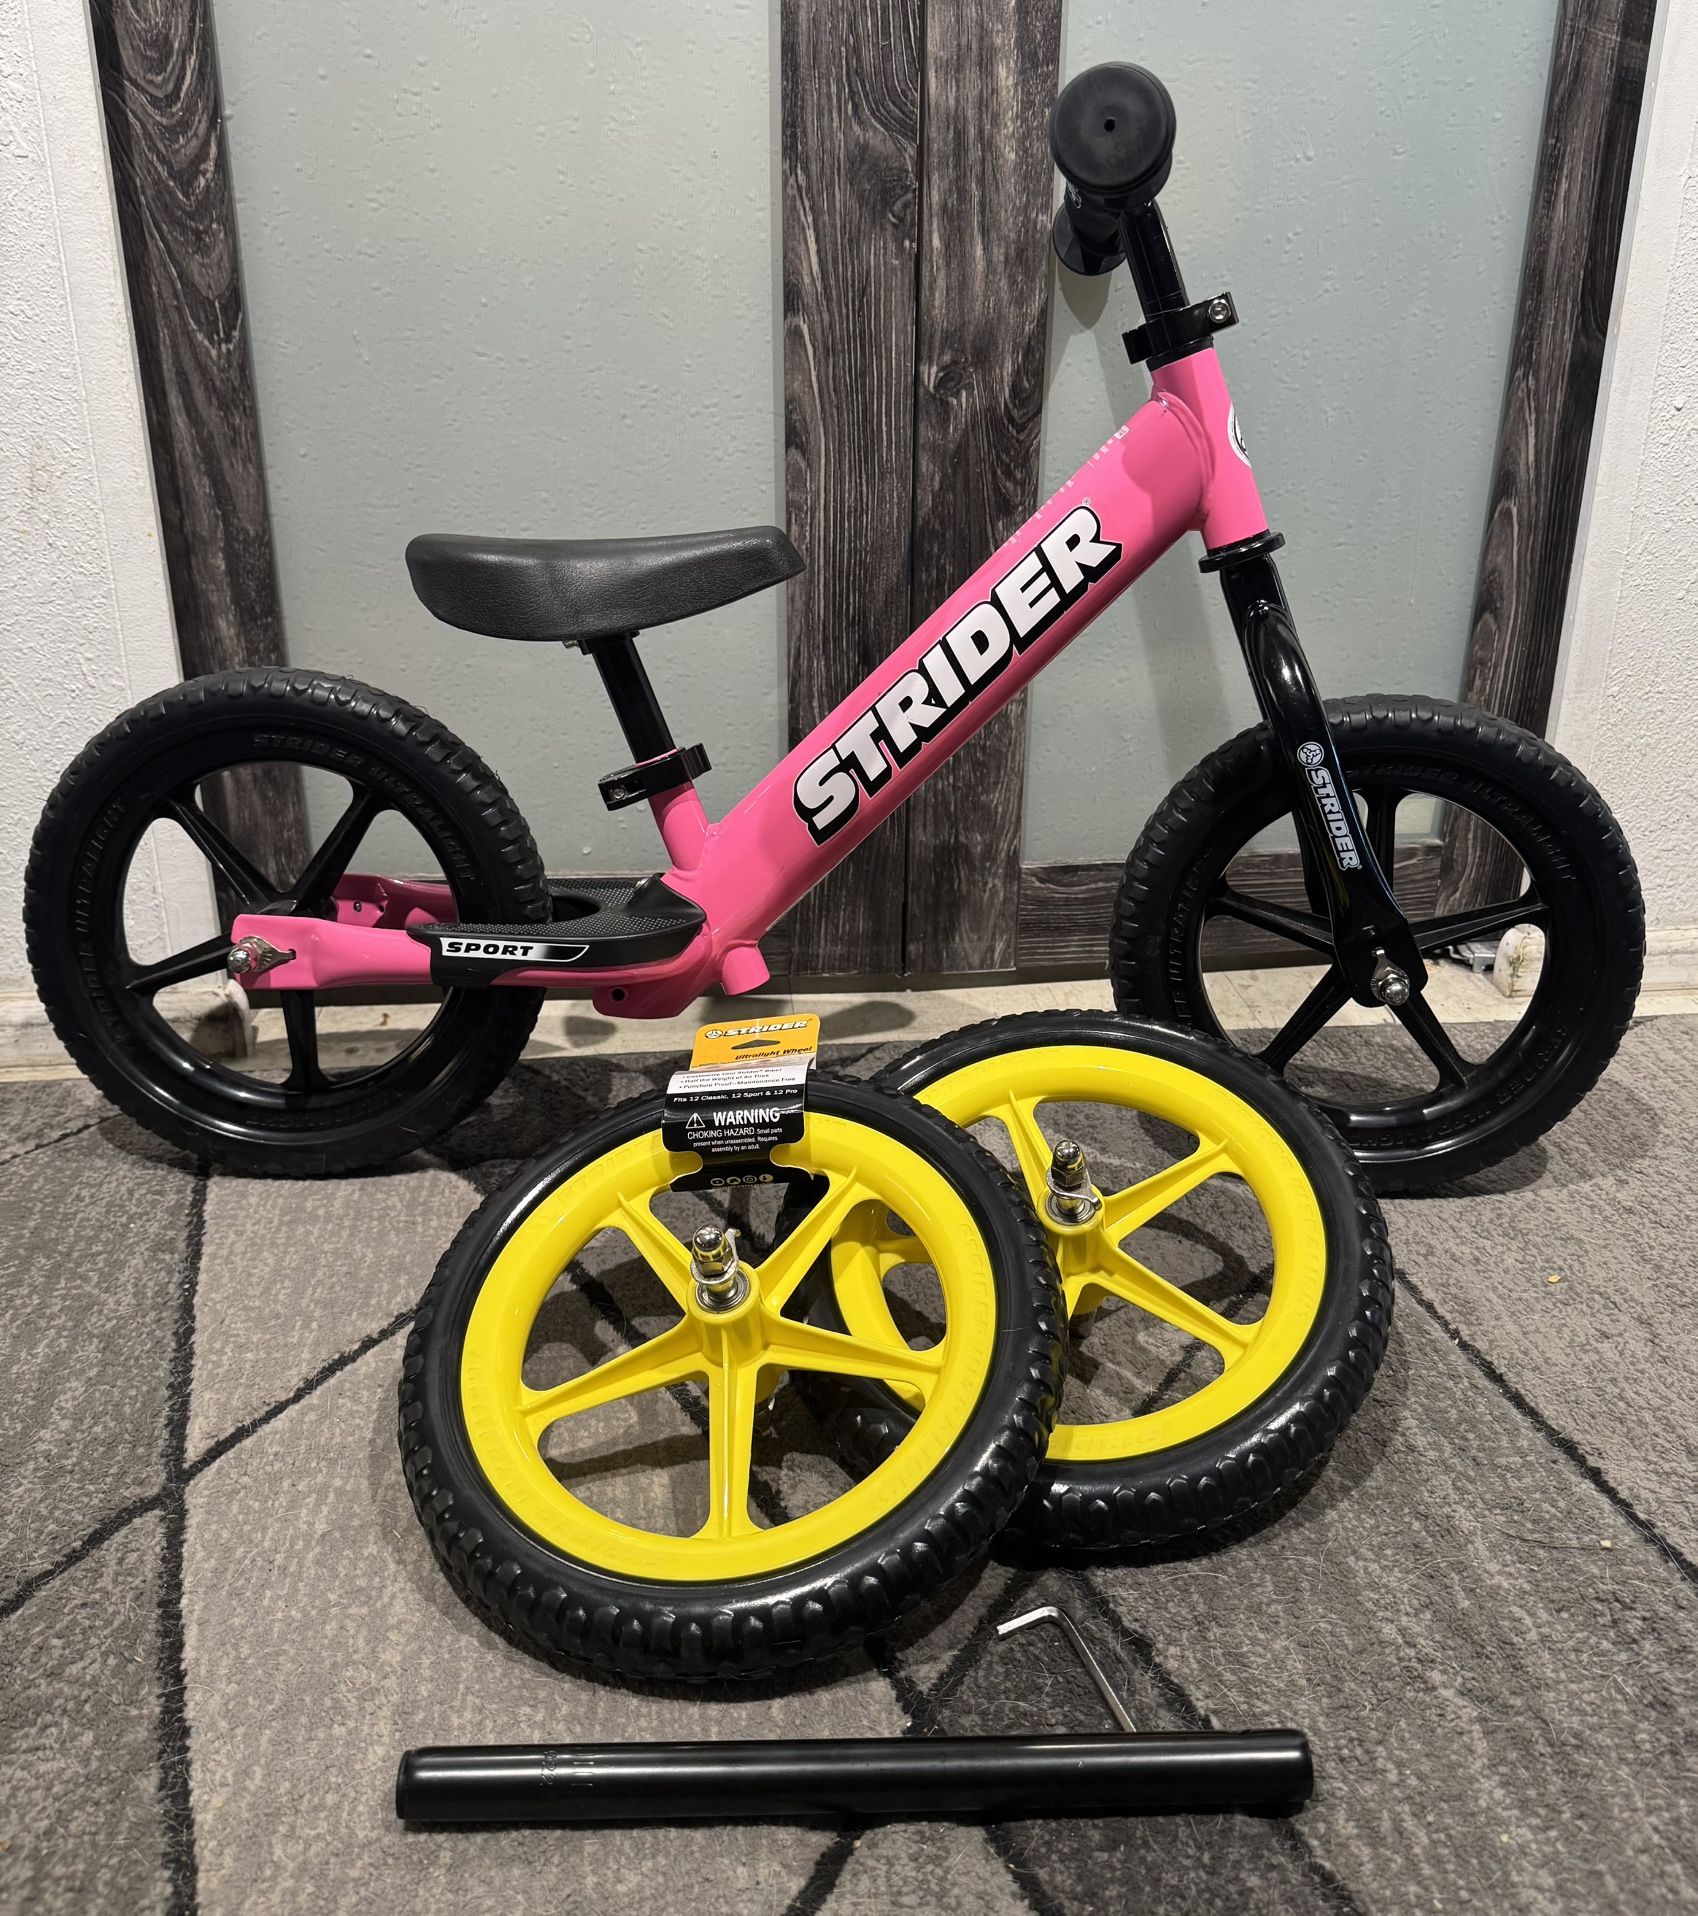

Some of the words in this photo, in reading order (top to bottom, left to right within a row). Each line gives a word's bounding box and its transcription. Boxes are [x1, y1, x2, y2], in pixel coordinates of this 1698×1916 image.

[793, 504, 1124, 848] STRIDER
[1305, 766, 1361, 871] STRIDER
[445, 941, 534, 957] SPORT
[722, 1020, 809, 1037] STRIDER
[735, 1050, 780, 1060] Ultralight
[782, 1046, 813, 1055] Wheel
[743, 1091, 764, 1100] Sport
[713, 1107, 781, 1127] WARNING
[687, 1127, 723, 1140] CHOKING
[770, 1127, 783, 1135] parts
[711, 1145, 733, 1153] assembly
[733, 1144, 741, 1152] by
